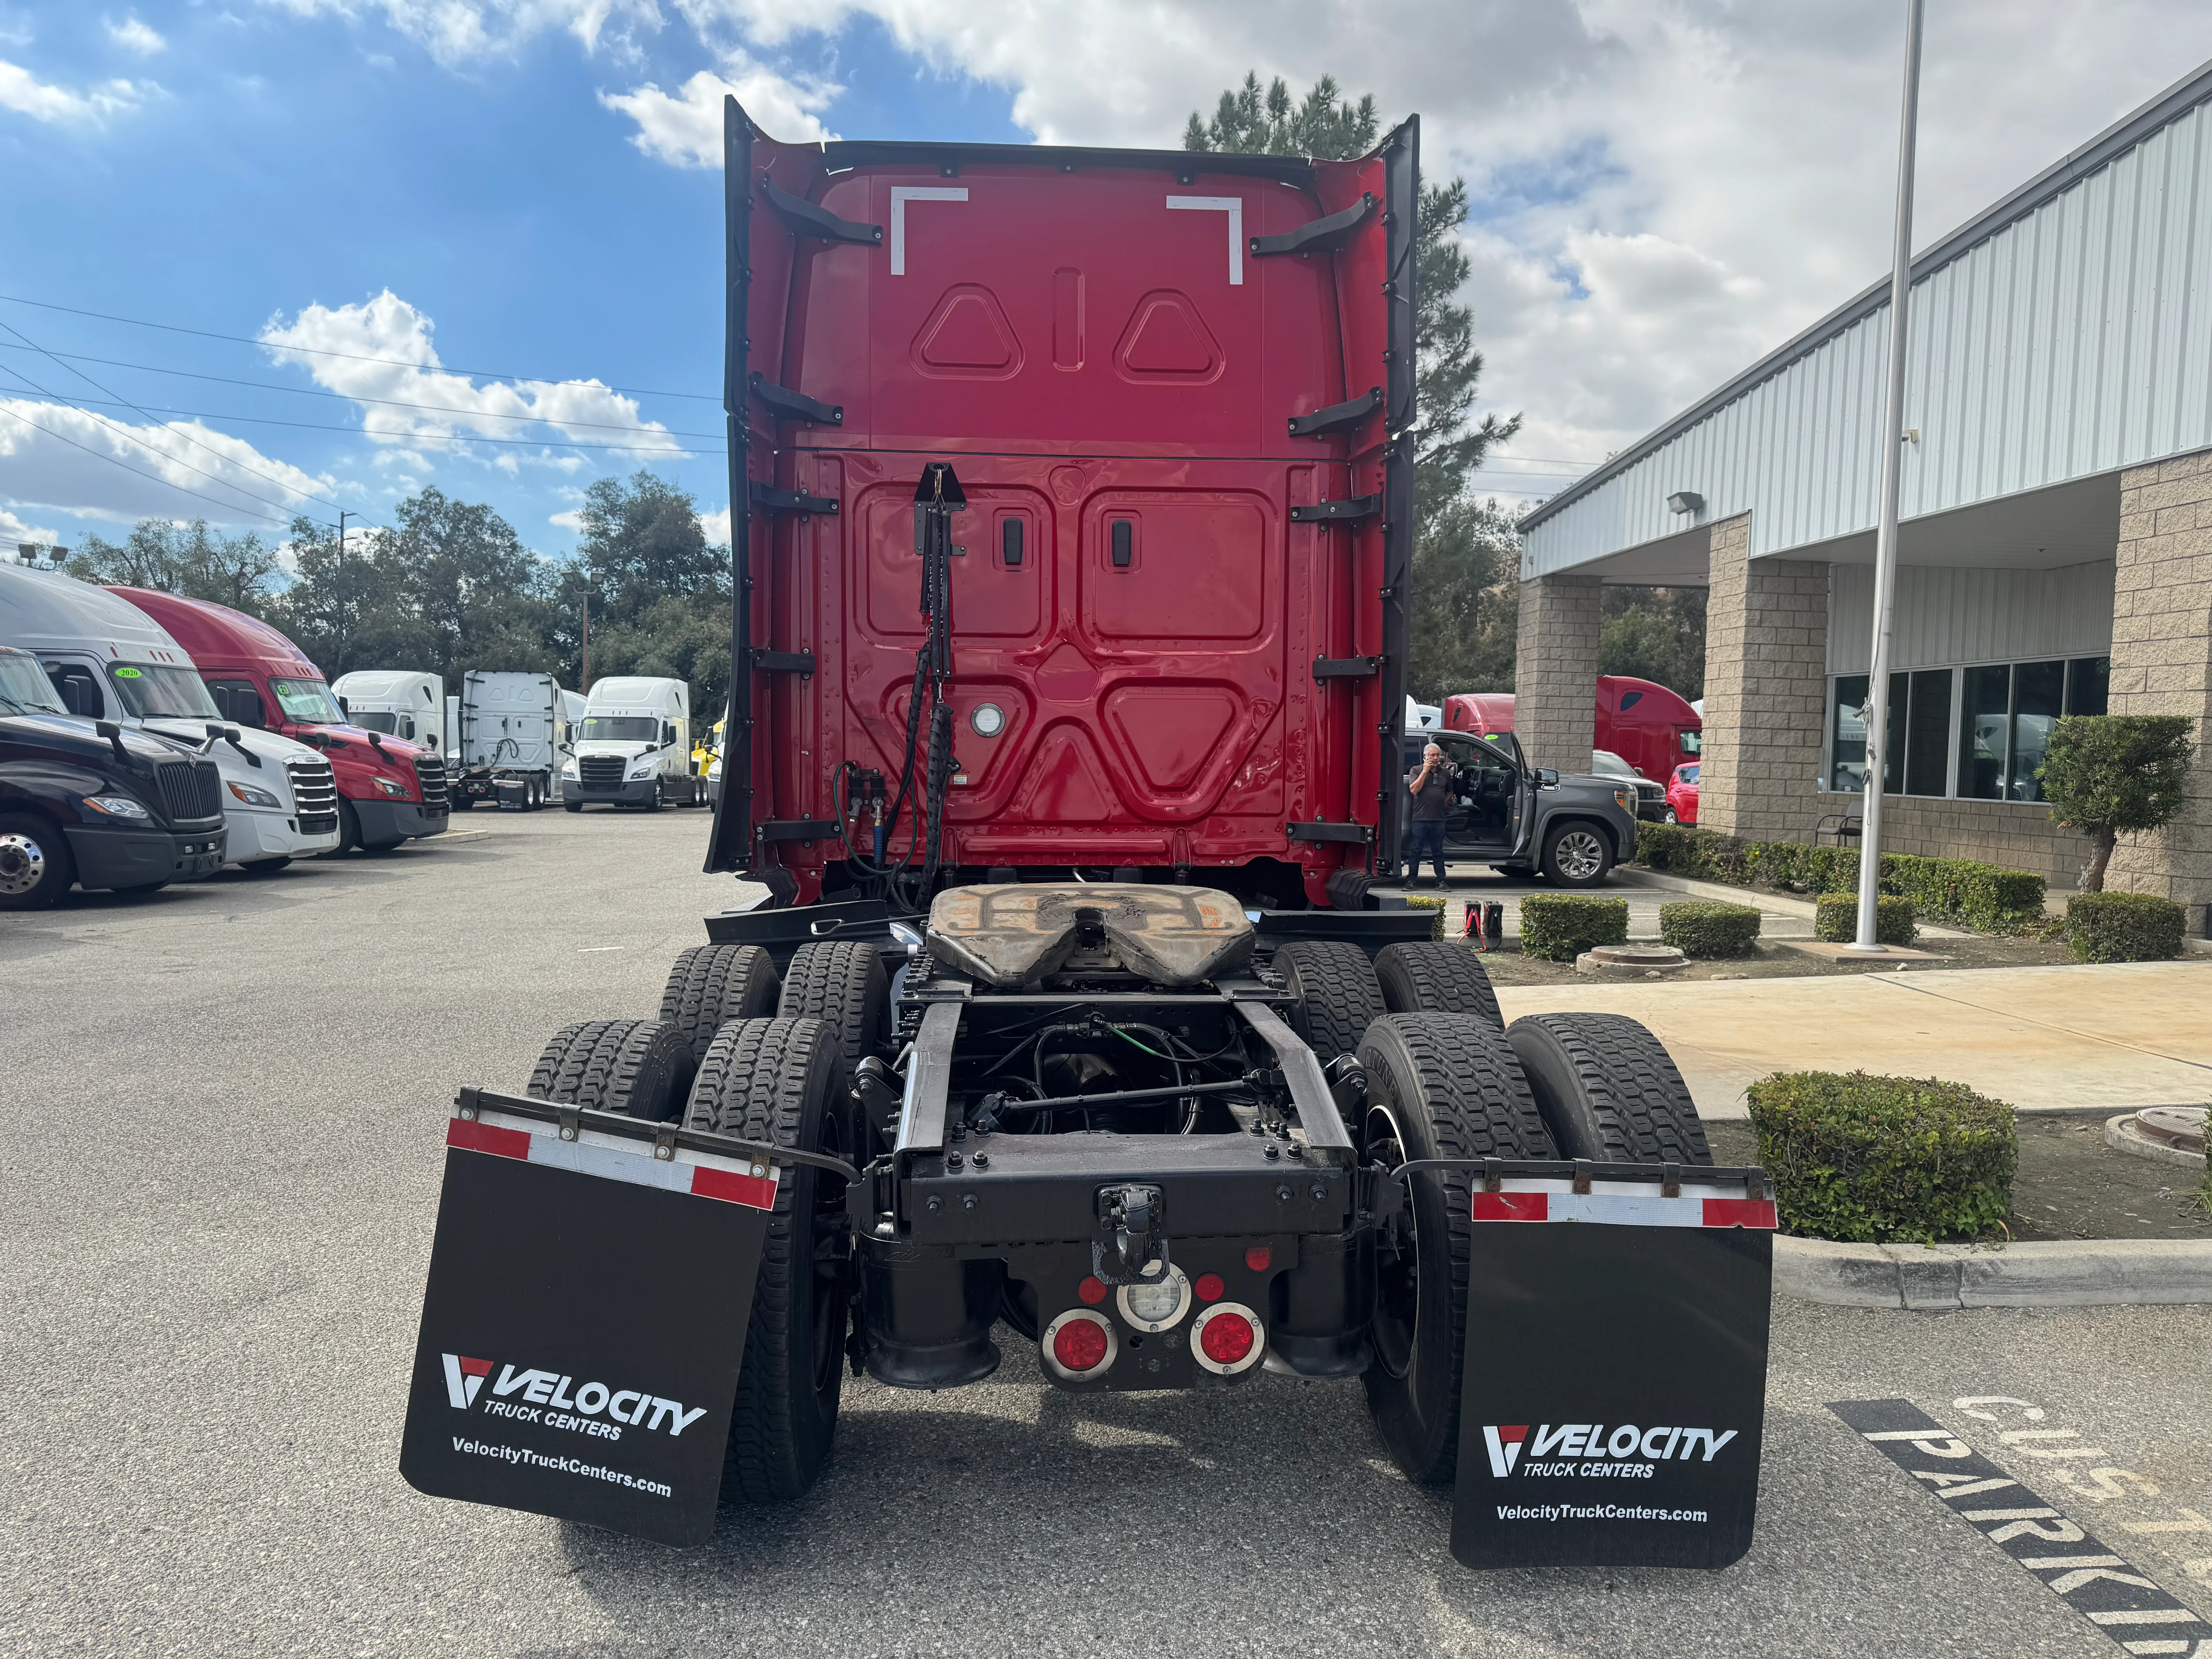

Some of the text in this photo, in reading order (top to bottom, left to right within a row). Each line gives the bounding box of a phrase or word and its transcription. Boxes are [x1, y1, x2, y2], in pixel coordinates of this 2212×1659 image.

[493, 1364, 707, 1436] VELOCITY
[484, 1400, 622, 1441] TRUCK CENTERS
[1530, 1425, 1738, 1461] VELOCITY
[453, 1437, 671, 1498] VelocityTruckCenters.com
[1524, 1463, 1655, 1478] TRUCK CENTERS
[1497, 1504, 1707, 1522] VelocityTruckCenters.com
